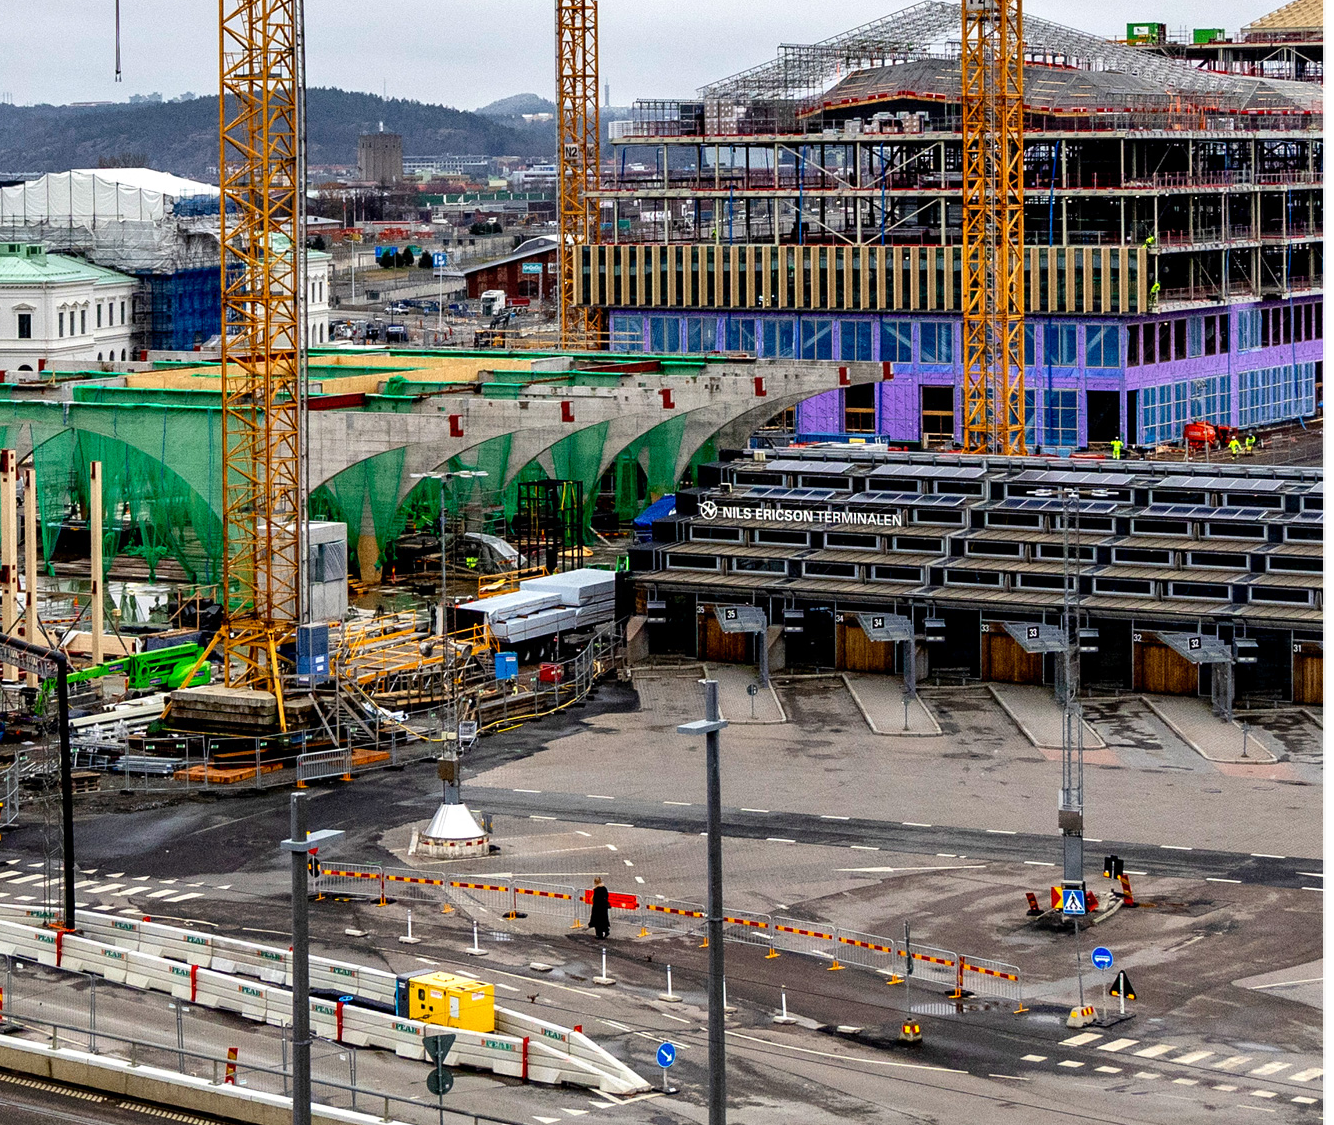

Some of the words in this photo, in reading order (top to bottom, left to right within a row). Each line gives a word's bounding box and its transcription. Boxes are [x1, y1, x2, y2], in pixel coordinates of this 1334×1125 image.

[566, 147, 577, 157] N2
[723, 507, 752, 519] NILS
[756, 508, 813, 522] ERICSON
[817, 510, 903, 527] TERMINALEN
[727, 610, 736, 619] 35
[835, 614, 844, 622] 34
[874, 618, 883, 627] 34
[980, 624, 989, 632] 33
[1029, 628, 1038, 638] 33
[1133, 633, 1142, 642] 32
[1191, 638, 1199, 648] 32
[1293, 644, 1302, 653] 31
[114, 921, 134, 930] PEAB
[186, 936, 206, 945] PEAB
[104, 950, 122, 959] PEAB
[260, 951, 281, 961] PEAB
[333, 967, 352, 976] PEAB
[241, 986, 261, 997] PEAB
[395, 1023, 417, 1034] PEAB
[544, 1028, 563, 1041] PEAB
[485, 1040, 512, 1051] PEAB
